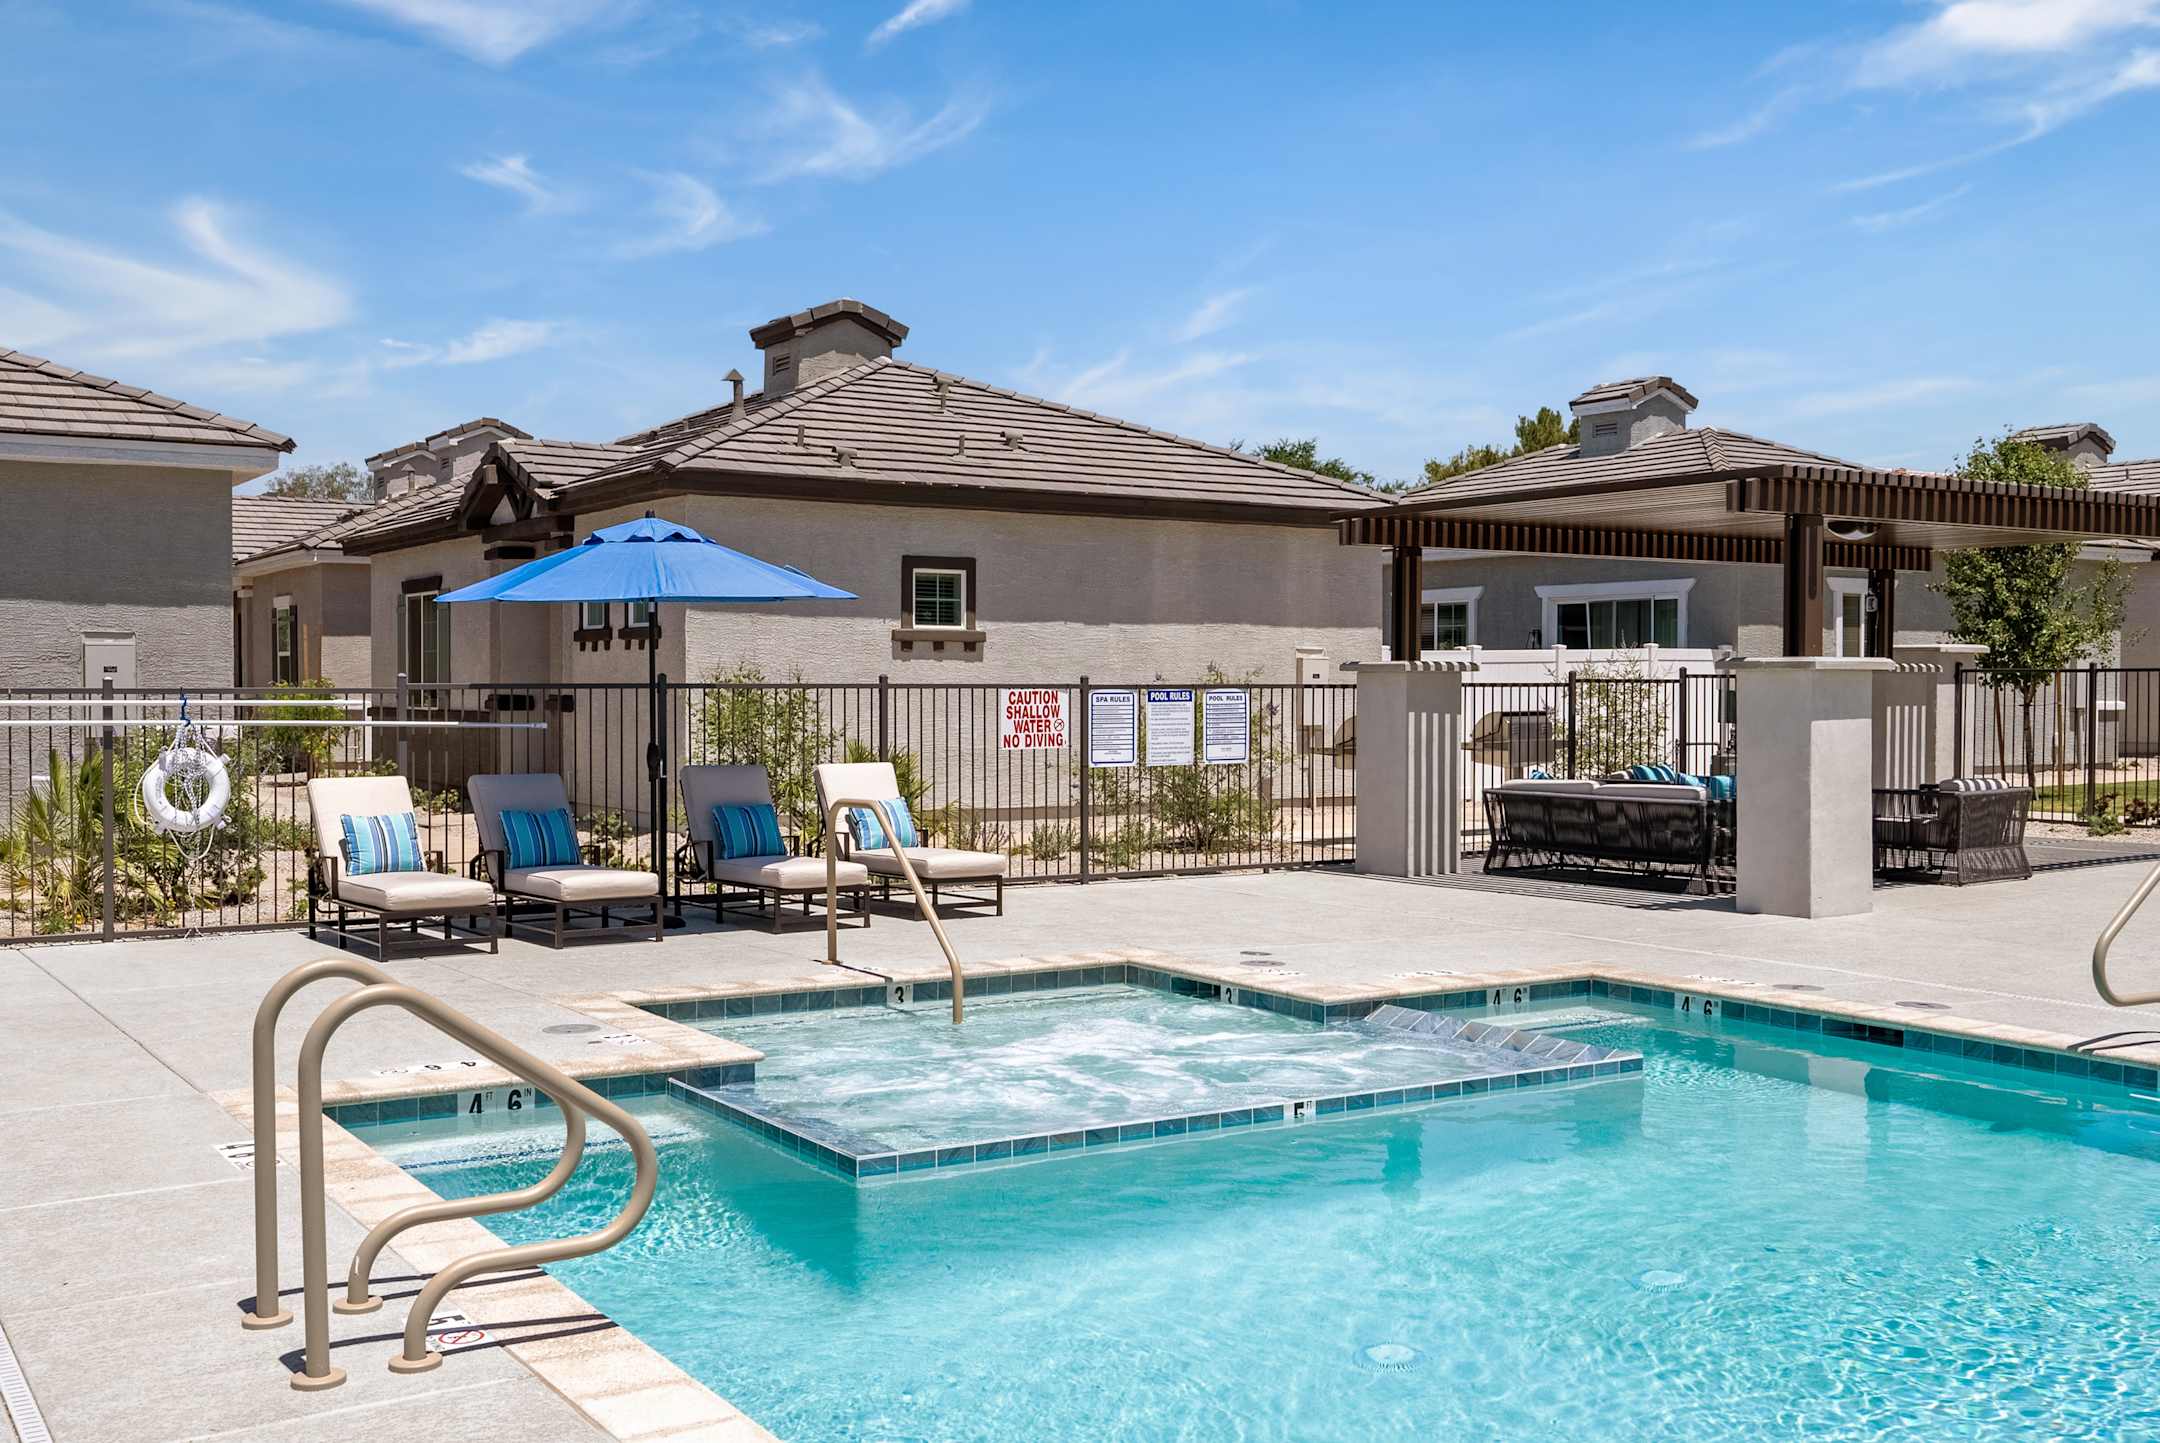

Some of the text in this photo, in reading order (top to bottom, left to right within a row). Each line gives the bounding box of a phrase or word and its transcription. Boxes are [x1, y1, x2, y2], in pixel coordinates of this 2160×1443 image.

[1008, 690, 1058, 705] CAUTION
[1150, 691, 1190, 700] POOL RULES
[1006, 705, 1060, 719] SHALLOW
[1013, 719, 1051, 733] WATER
[1003, 733, 1063, 748] NO DIVING
[468, 1092, 482, 1114] 4
[508, 1089, 522, 1110] 6
